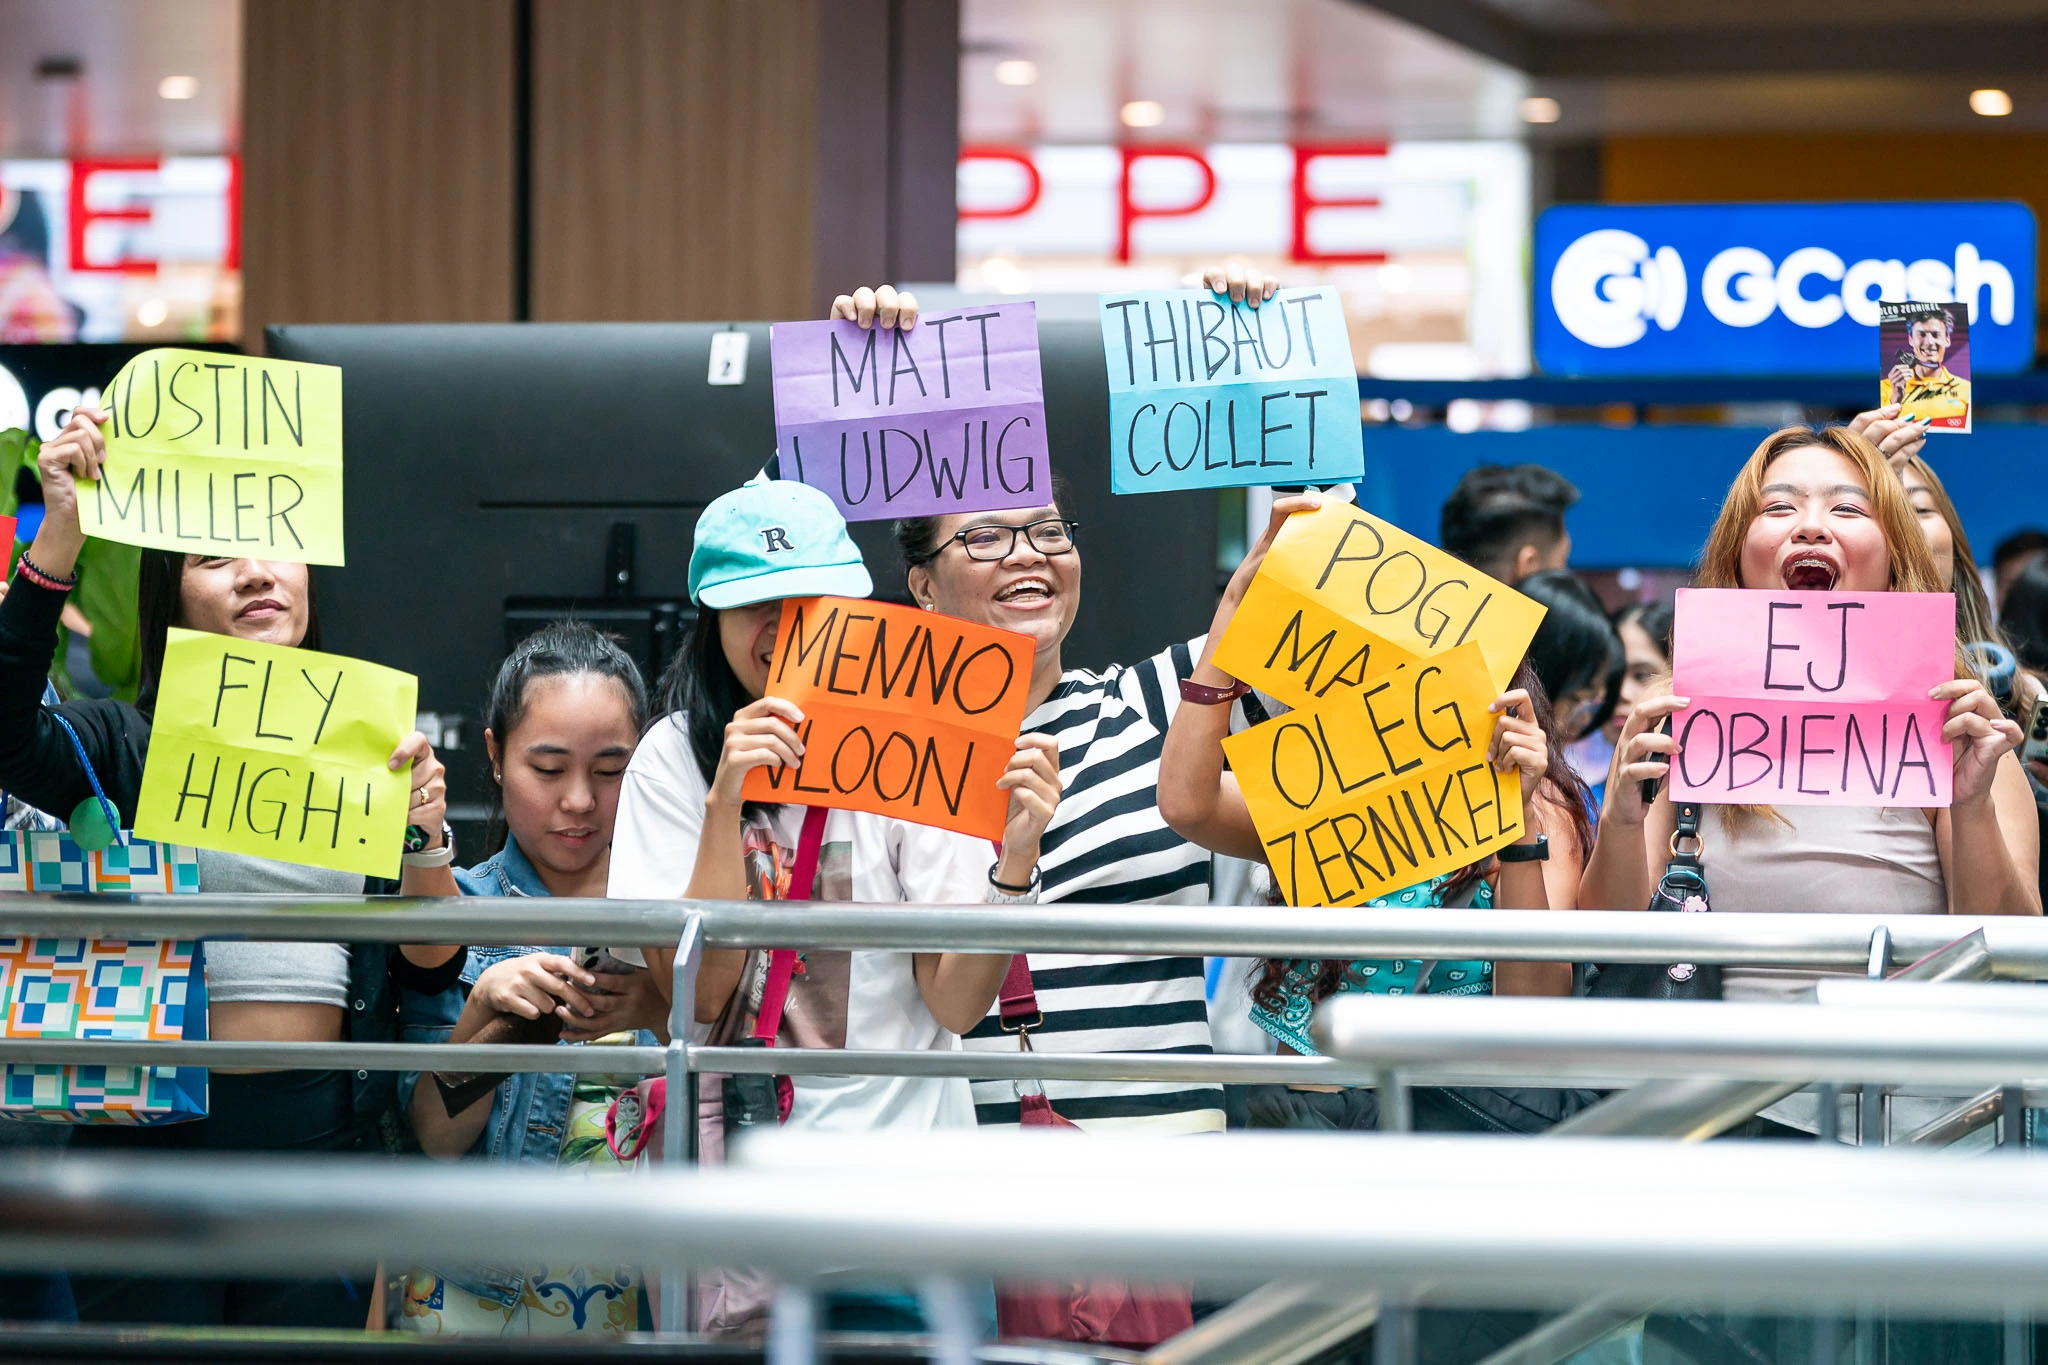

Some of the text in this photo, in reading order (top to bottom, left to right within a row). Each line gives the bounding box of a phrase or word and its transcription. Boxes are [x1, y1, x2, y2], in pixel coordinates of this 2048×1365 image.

[1702, 242, 2014, 328] GCash
[830, 312, 1001, 408] MATT
[1106, 294, 1323, 385] THIBAUT
[1128, 390, 1328, 477] COLLET
[96, 465, 304, 549] MILLER
[761, 527, 795, 553] R
[1316, 519, 1492, 648] POGI
[777, 606, 1014, 715] MENNO
[1264, 610, 1405, 697] MA
[1764, 602, 1865, 692] EJ
[212, 652, 343, 744] FLY
[1272, 666, 1471, 810] OLEG
[1678, 709, 1936, 798] OBIENA
[174, 753, 371, 849] HIGH!
[1267, 762, 1517, 907] ZERNIKEL
